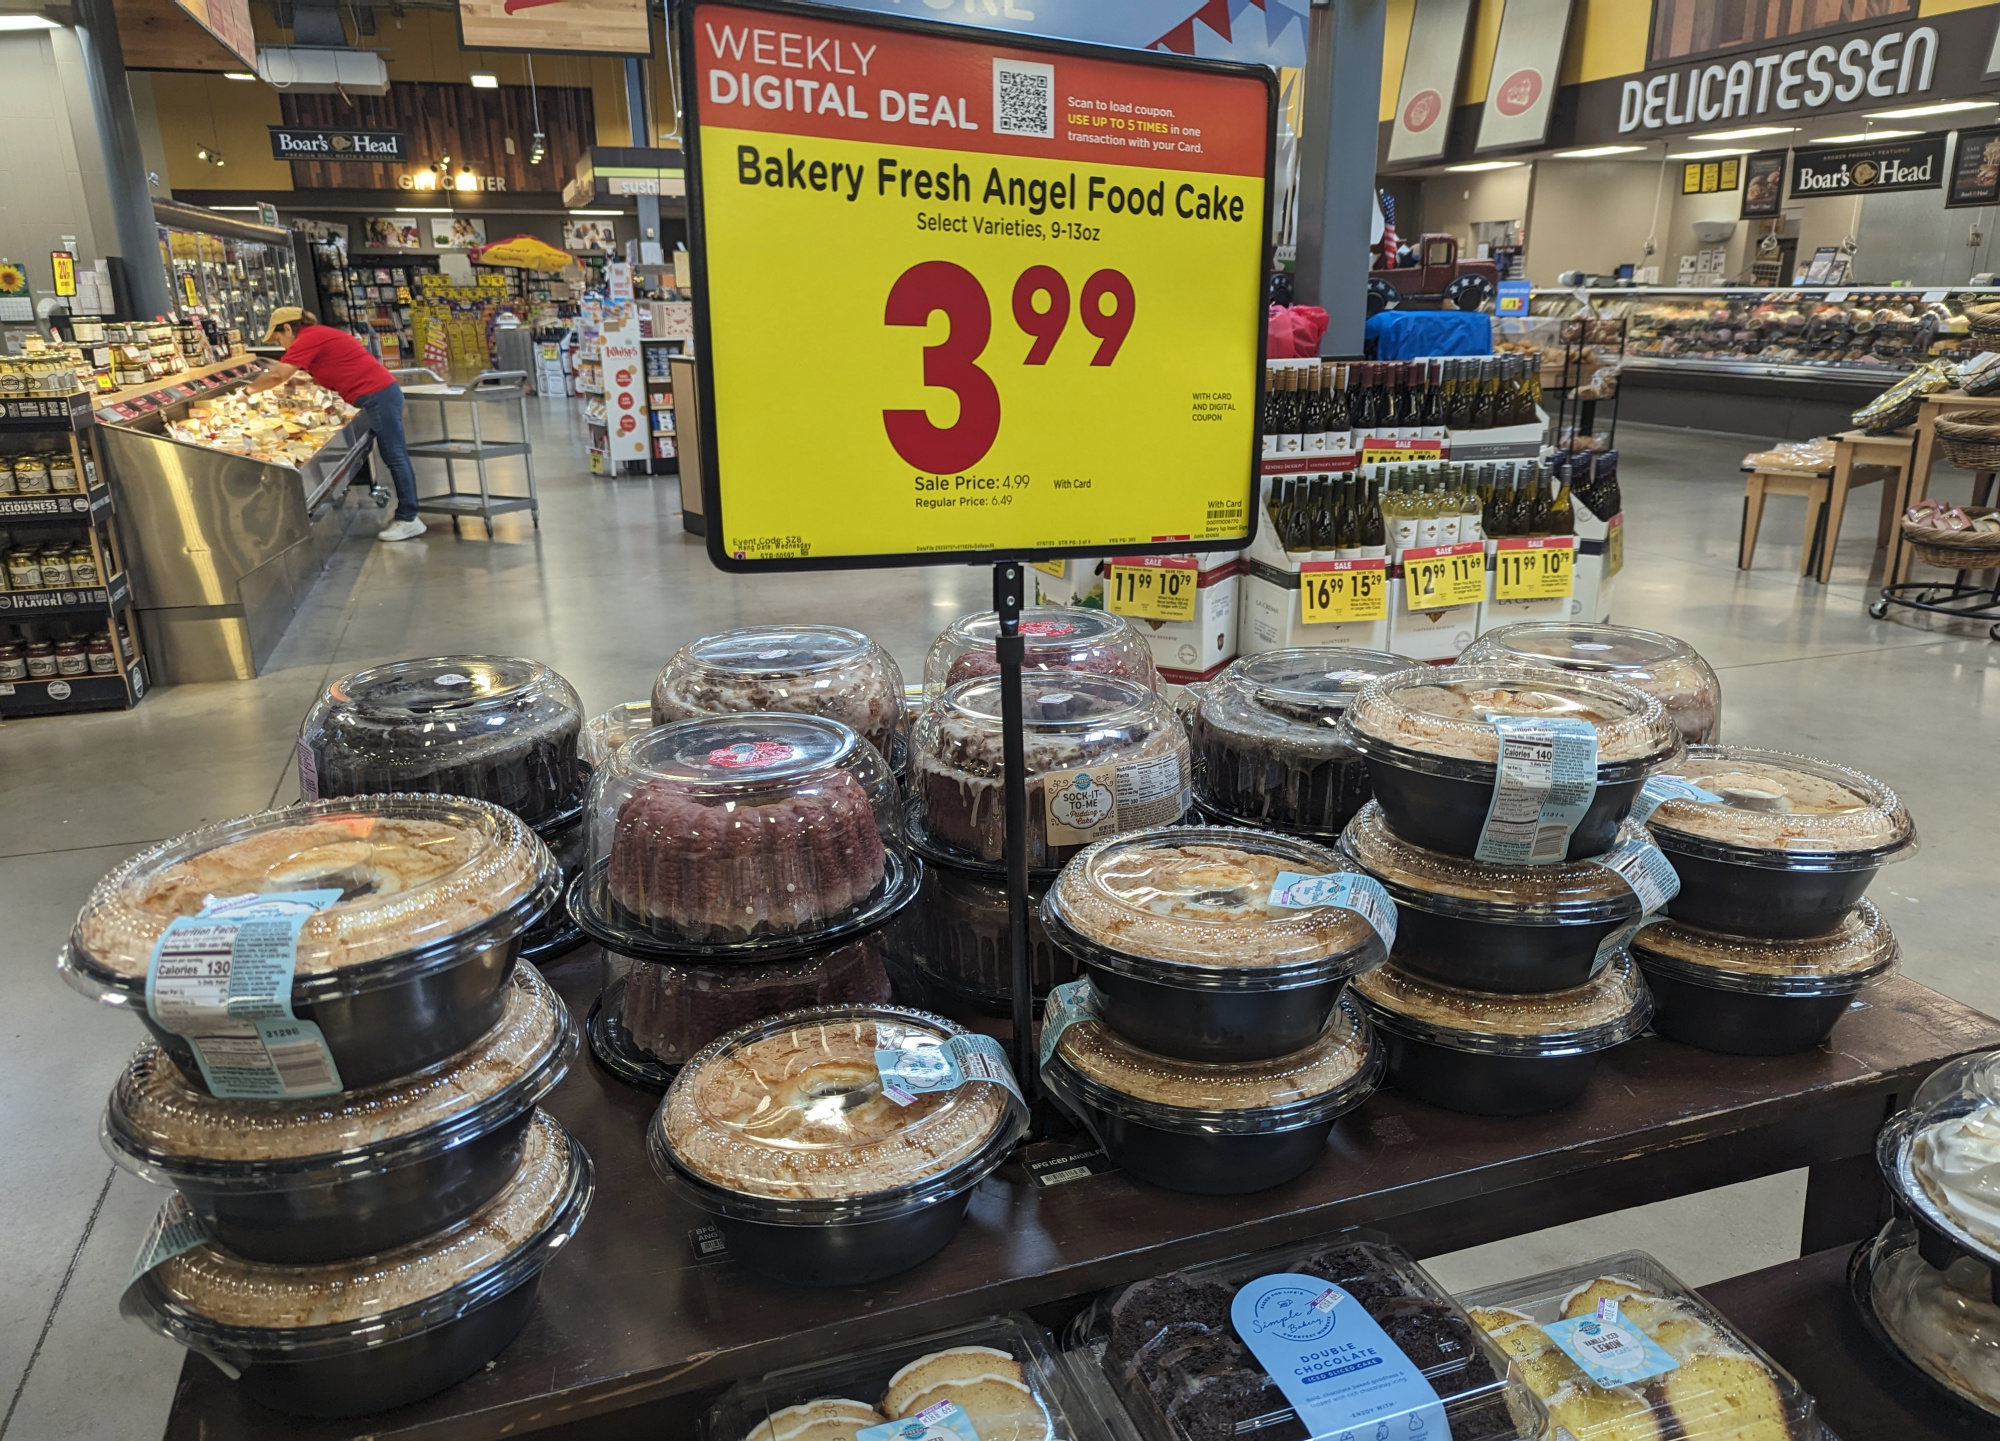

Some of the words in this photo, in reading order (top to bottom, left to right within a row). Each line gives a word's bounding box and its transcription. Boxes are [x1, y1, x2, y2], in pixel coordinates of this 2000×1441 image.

[705, 22, 877, 77] WEEKLY
[1619, 26, 1939, 134] DELICATESSEN
[709, 68, 869, 119] DIGITAL
[880, 89, 979, 131] DEAL
[1067, 96, 1094, 109] Scan
[1096, 99, 1108, 111] to
[1110, 100, 1133, 114] load
[1134, 105, 1175, 119] coupon.
[1067, 113, 1090, 126] USE
[1092, 115, 1108, 128] UP
[1110, 117, 1125, 129] TO
[1127, 119, 1136, 131] 5
[1137, 120, 1168, 134] TIMES
[1170, 124, 1180, 135] in
[1182, 127, 1202, 138] one
[279, 132, 329, 152] Boar's
[354, 135, 398, 154] Head
[1067, 131, 1127, 146] transaction
[1128, 137, 1151, 149] with
[1152, 140, 1176, 152] your
[1177, 141, 1204, 154] Card.
[1799, 163, 1850, 191] Boar's
[1879, 155, 1932, 185] Head
[621, 179, 660, 195] sushi
[737, 144, 865, 202] Bakery
[878, 157, 971, 203] Fresh
[983, 166, 1076, 216] Angel
[1089, 176, 1165, 217] Food
[1175, 183, 1245, 223] Cake
[916, 212, 969, 234] Select
[972, 216, 1047, 242] Varieties,
[1051, 221, 1101, 242] 9-13oz
[1191, 392, 1211, 401] WITH
[1212, 392, 1233, 401] CARD
[1191, 403, 1208, 411] AND
[1209, 403, 1236, 411] DIGITAL
[1191, 413, 1222, 422] COUPON
[1395, 440, 1412, 449] SALE
[914, 475, 950, 492] Sale
[954, 474, 1000, 491] Price:
[1002, 474, 1031, 490] 4.99
[1053, 478, 1072, 490] With
[1073, 478, 1092, 489] Card
[0, 502, 58, 514] ICIOUSNESS
[915, 497, 957, 510] Regular
[959, 495, 989, 508] Price:
[991, 495, 1013, 507] 6.49
[1207, 500, 1225, 509] With
[1225, 500, 1243, 508] Card
[732, 537, 757, 547] Event
[758, 536, 784, 546] Code:
[1527, 540, 1544, 548] SALE
[1435, 546, 1453, 556] SALE
[1144, 558, 1162, 567] SALE
[1333, 561, 1352, 570] SALE
[1504, 747, 1531, 758] Calories
[1536, 750, 1553, 760] 140
[1068, 798, 1098, 810] TO-ME
[1069, 809, 1099, 818] Pudding
[1076, 817, 1094, 825] Cake
[171, 926, 211, 938] Nutrition
[212, 925, 239, 936] Facts
[158, 964, 199, 975] Calories
[207, 960, 231, 975] 130
[1031, 1161, 1049, 1170] BFG
[1049, 1157, 1068, 1166] ICED
[1069, 1151, 1096, 1161] ANGEL
[695, 1225, 715, 1235] BFG
[1252, 1309, 1303, 1334] Simple
[1288, 1317, 1324, 1334] Bakery
[1582, 1337, 1607, 1347] VANILLA
[1606, 1332, 1620, 1341] ICED
[1592, 1338, 1624, 1354] LEMON
[1300, 1342, 1357, 1363] DOUBLE
[1293, 1347, 1377, 1376] CHOCOLATE
[1307, 1373, 1327, 1383] ICED
[1327, 1364, 1356, 1377] SLICED
[1356, 1358, 1378, 1369] CAKE
